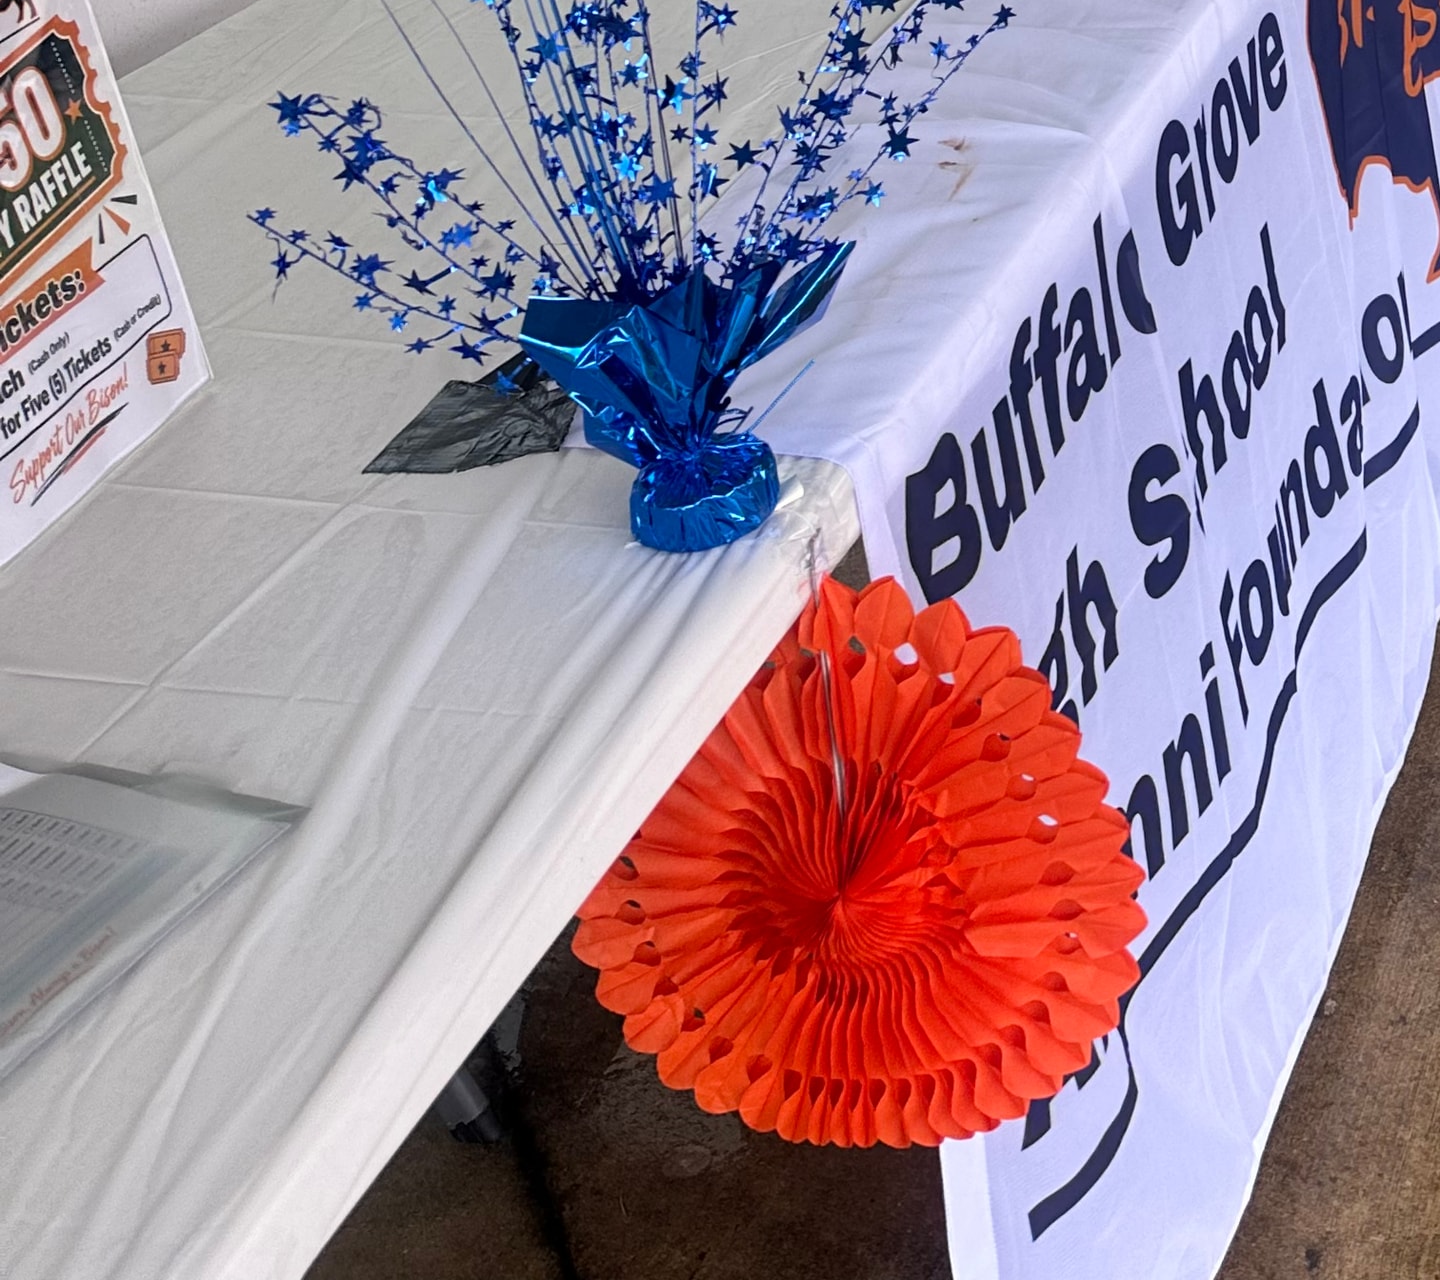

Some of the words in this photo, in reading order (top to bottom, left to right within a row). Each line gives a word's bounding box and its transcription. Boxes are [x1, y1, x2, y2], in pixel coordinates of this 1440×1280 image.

[12, 141, 92, 234] RAFFLE
[1156, 12, 1287, 266] Grove
[0, 411, 21, 440] for
[21, 389, 50, 422] Five
[49, 371, 65, 400] (5)
[63, 337, 112, 391] Tickets
[113, 320, 131, 342] (Cash
[137, 293, 161, 318] Credit)
[28, 350, 50, 376] (Cash
[49, 331, 70, 355] Only)
[1128, 222, 1286, 600] Shool
[10, 425, 64, 504] Support
[64, 408, 86, 444] Our
[86, 362, 129, 423] Bison!
